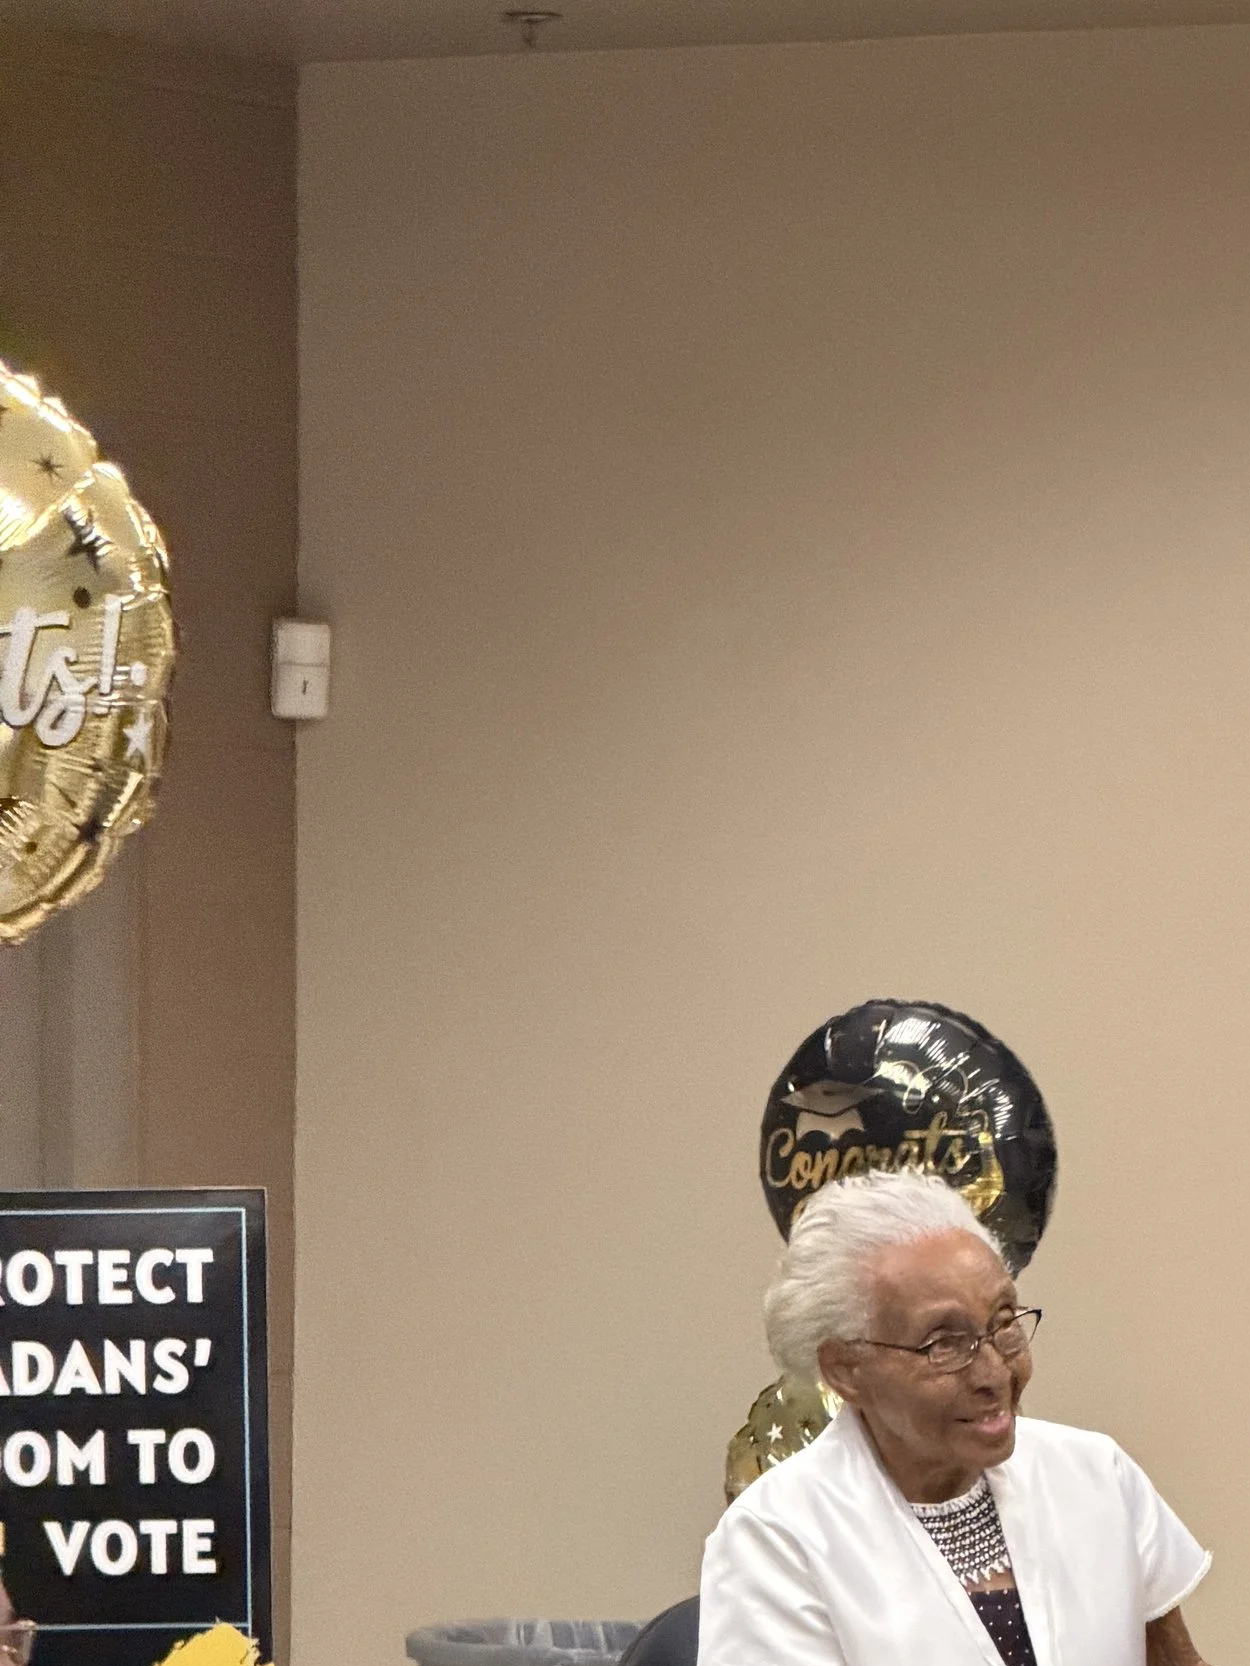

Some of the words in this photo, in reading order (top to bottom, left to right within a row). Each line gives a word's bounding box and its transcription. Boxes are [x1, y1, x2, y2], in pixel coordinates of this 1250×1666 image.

[0, 1249, 214, 1306] OTECT
[0, 1339, 212, 1396] DANS'
[0, 1429, 106, 1487] OM
[127, 1428, 216, 1485] TO
[43, 1519, 217, 1576] VOTE
